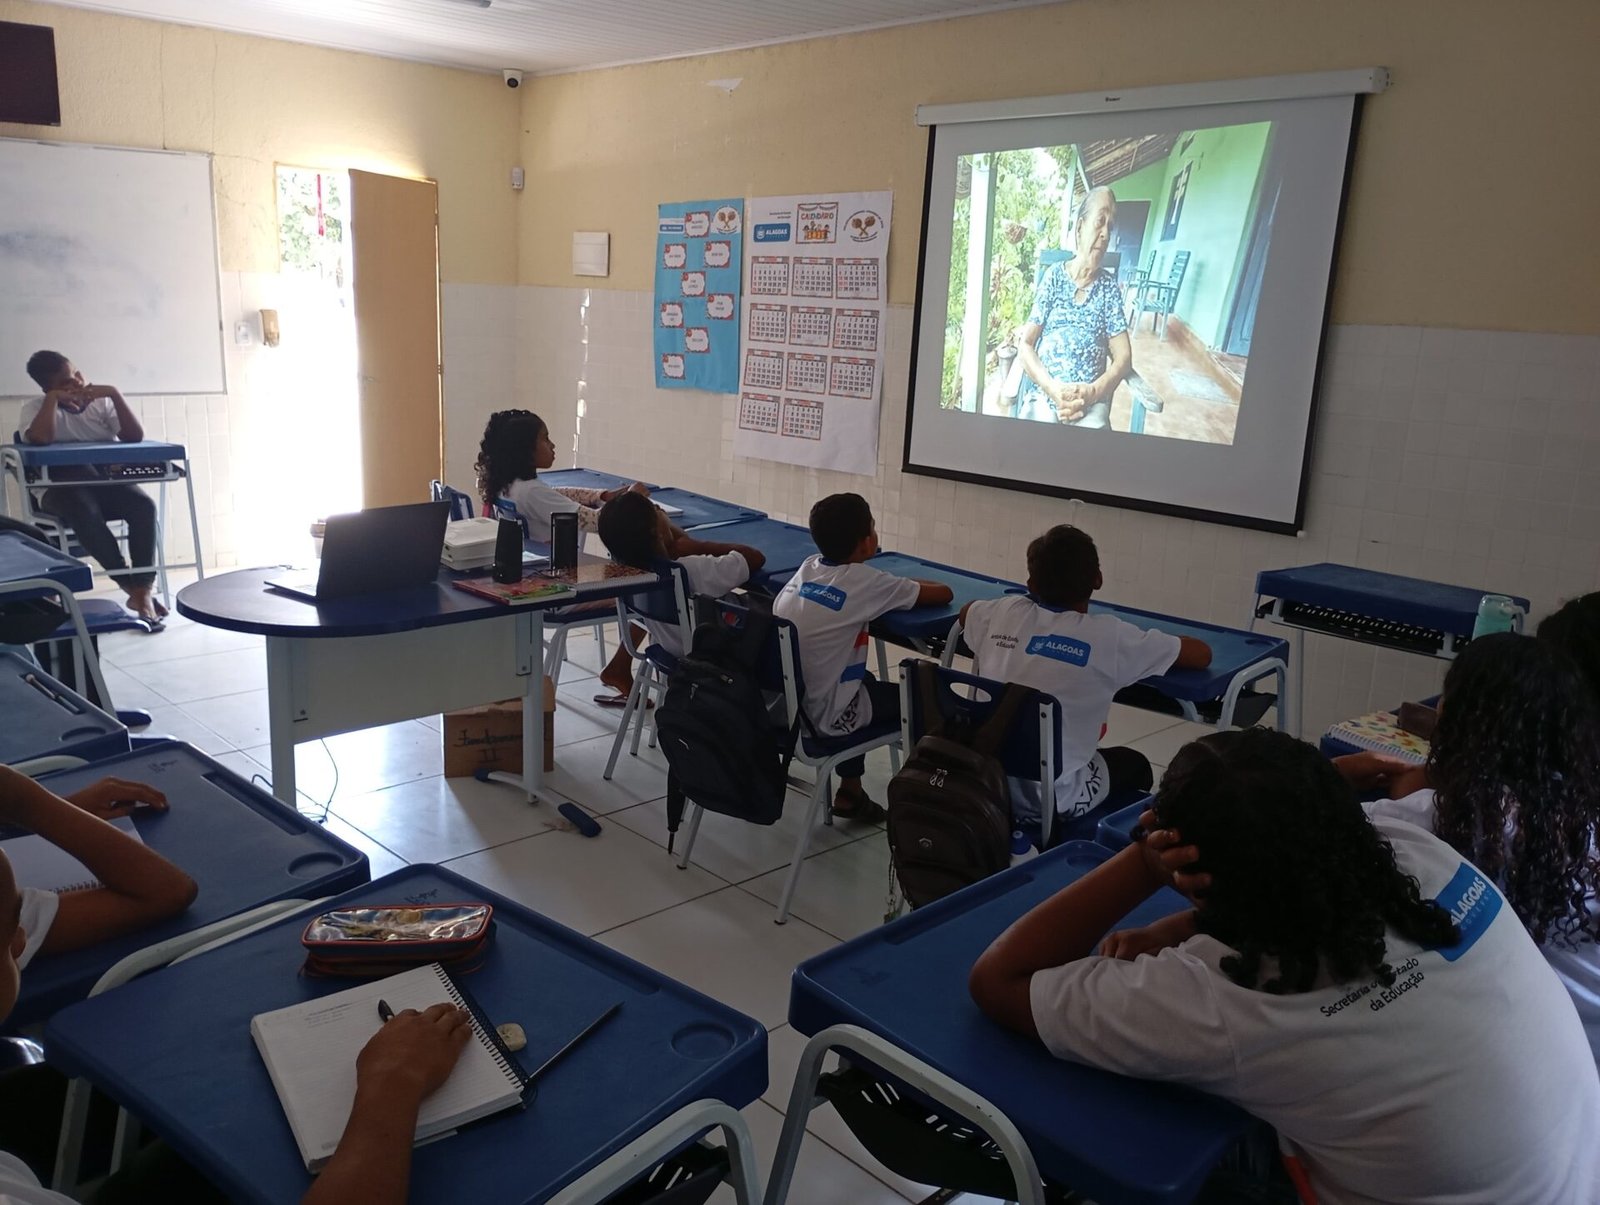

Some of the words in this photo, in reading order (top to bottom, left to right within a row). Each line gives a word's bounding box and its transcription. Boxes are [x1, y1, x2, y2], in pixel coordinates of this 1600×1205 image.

[1046, 641, 1085, 657] ALAGOAS
[1450, 876, 1486, 926] ALAGOAS
[1370, 1000, 1384, 1012] da
[1380, 971, 1424, 1003] Educação
